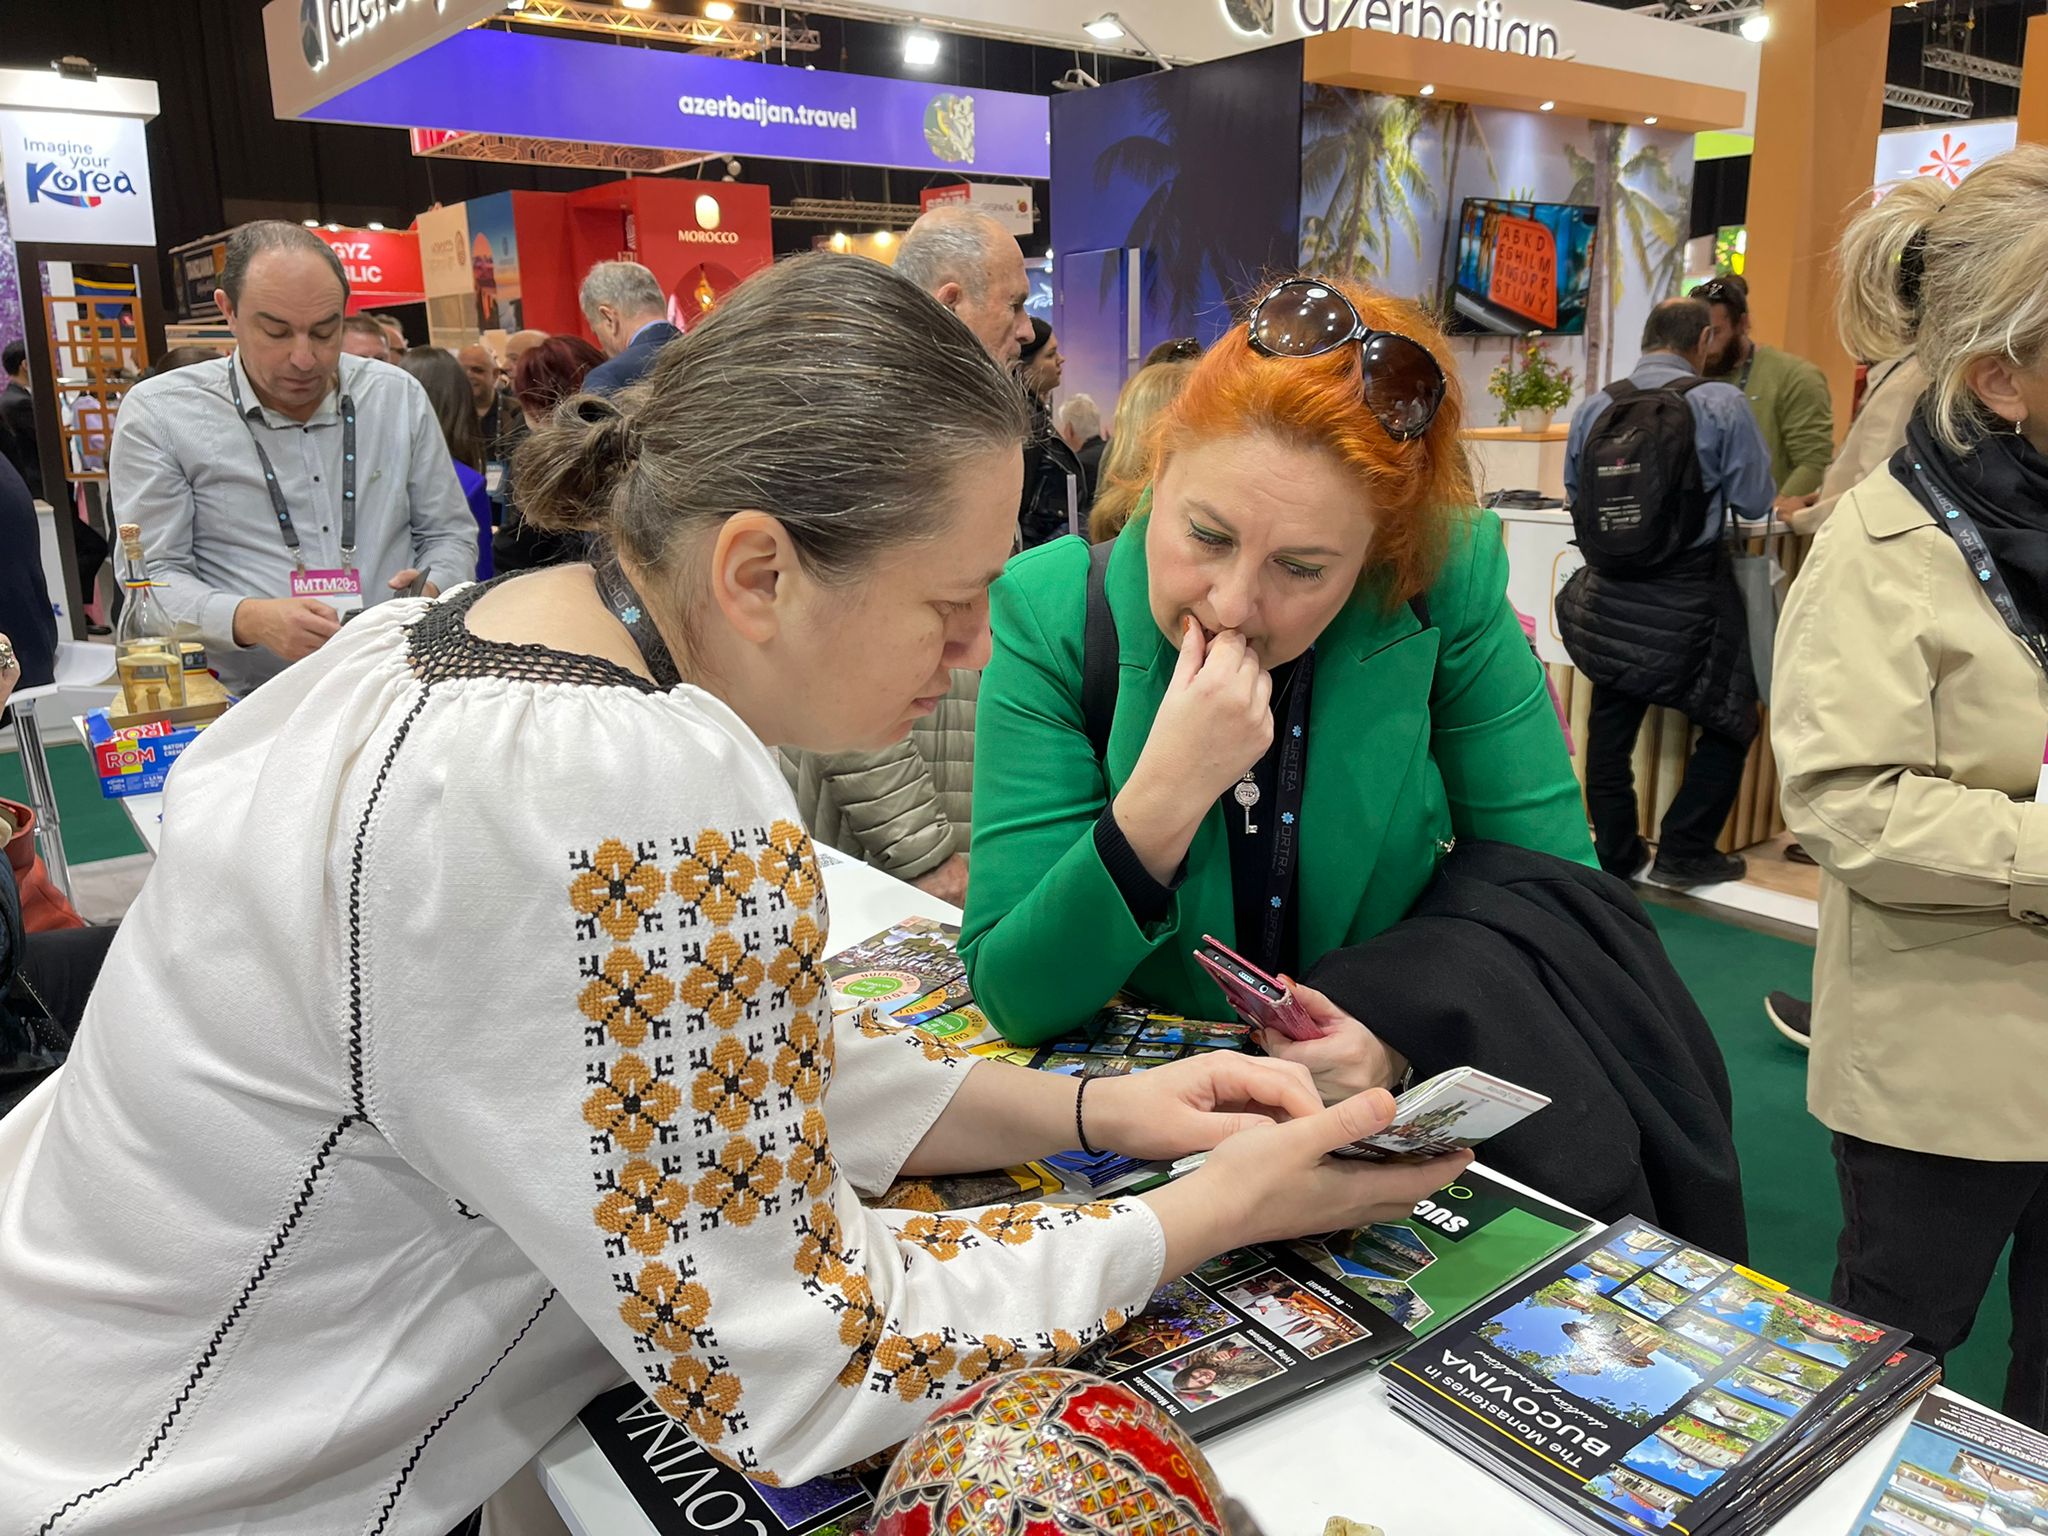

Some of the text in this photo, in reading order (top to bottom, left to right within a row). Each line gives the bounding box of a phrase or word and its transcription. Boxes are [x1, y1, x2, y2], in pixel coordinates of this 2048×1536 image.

[678, 95, 857, 130] azerbaijan.travel
[24, 137, 93, 156] Imagine
[70, 155, 111, 169] your
[26, 162, 136, 208] Korea
[330, 242, 372, 261] GYZ
[678, 230, 739, 244] MOROCCO
[106, 746, 156, 769] ROM
[1286, 738, 1300, 792] ORTRA
[1413, 1200, 1470, 1233] SUC
[1246, 1329, 1297, 1367] Living Traditions
[1132, 1376, 1181, 1417] The Monasteries
[1441, 1348, 1611, 1457] BUCOVINA
[1424, 1364, 1583, 1468] The Monasteries in
[1934, 1418, 1985, 1444] BUKOVINA
[1985, 1440, 2001, 1451] OF
[2001, 1445, 2048, 1469] MUSEUM
